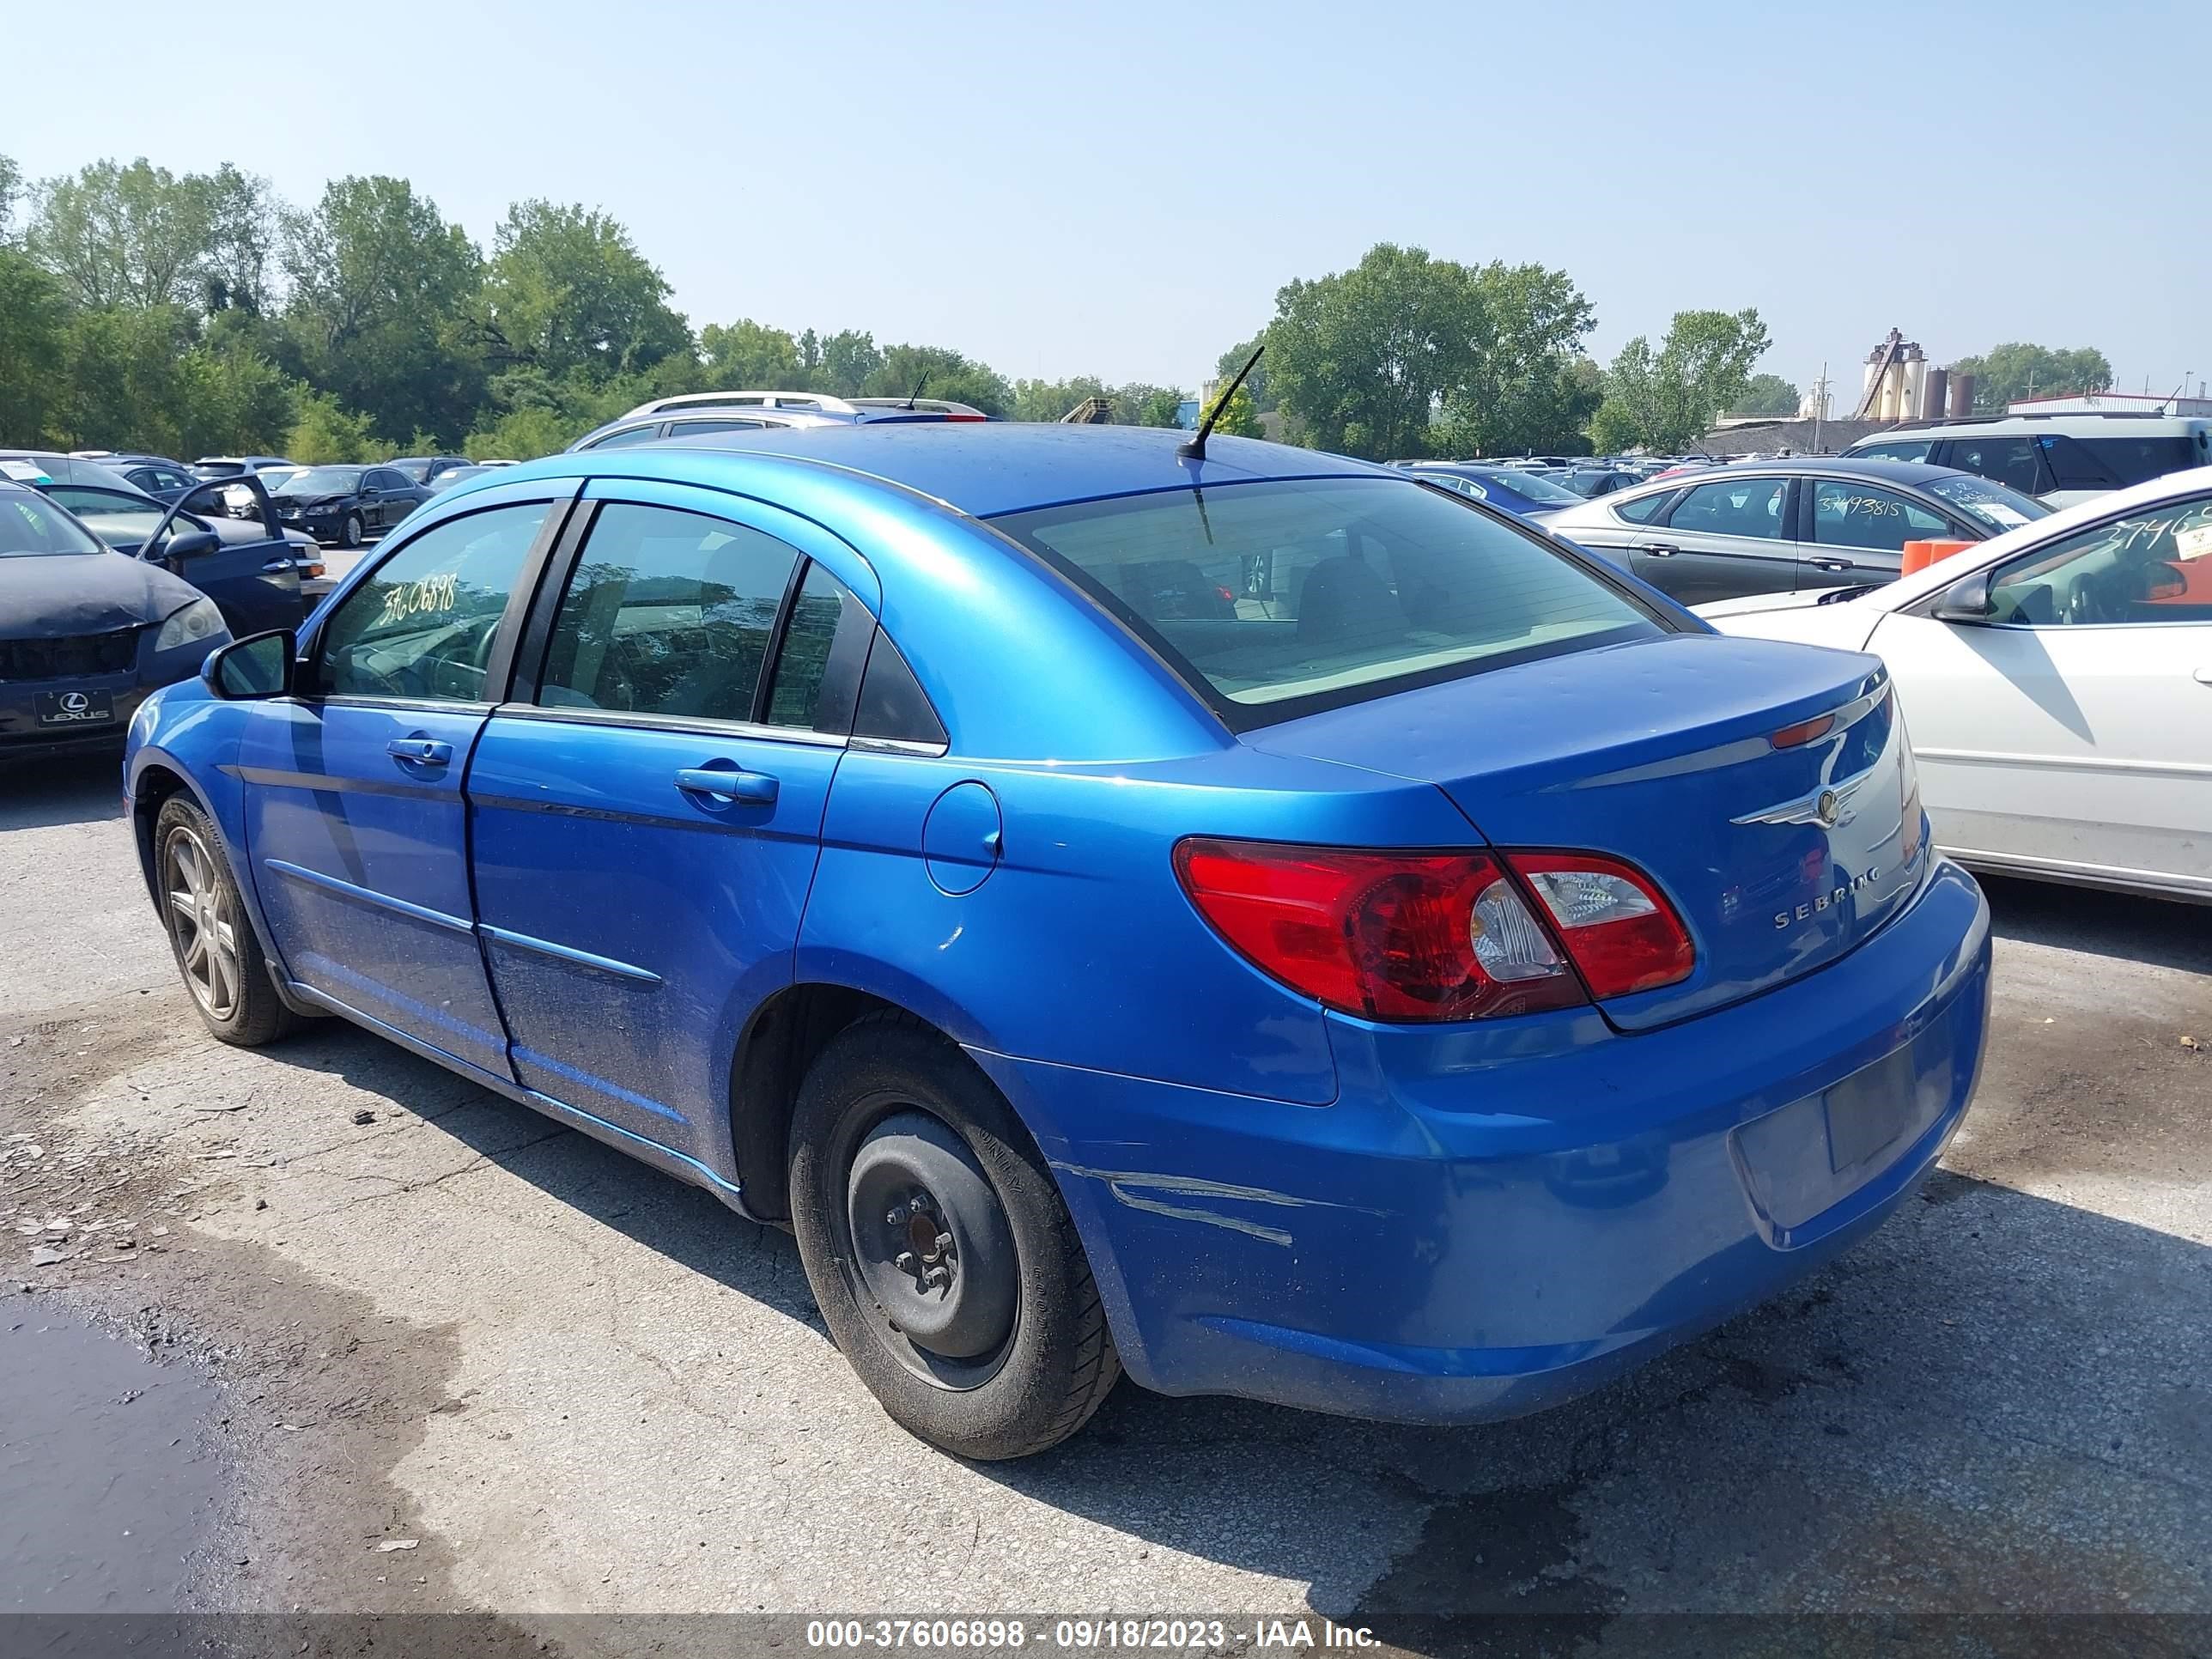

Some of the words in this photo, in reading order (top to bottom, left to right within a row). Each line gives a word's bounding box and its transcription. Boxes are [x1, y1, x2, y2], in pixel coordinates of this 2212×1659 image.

[1819, 495, 1904, 516] 37493815
[380, 573, 458, 626] 37606898
[41, 710, 110, 722] LEXUS
[1774, 866, 1880, 929] SEBRING
